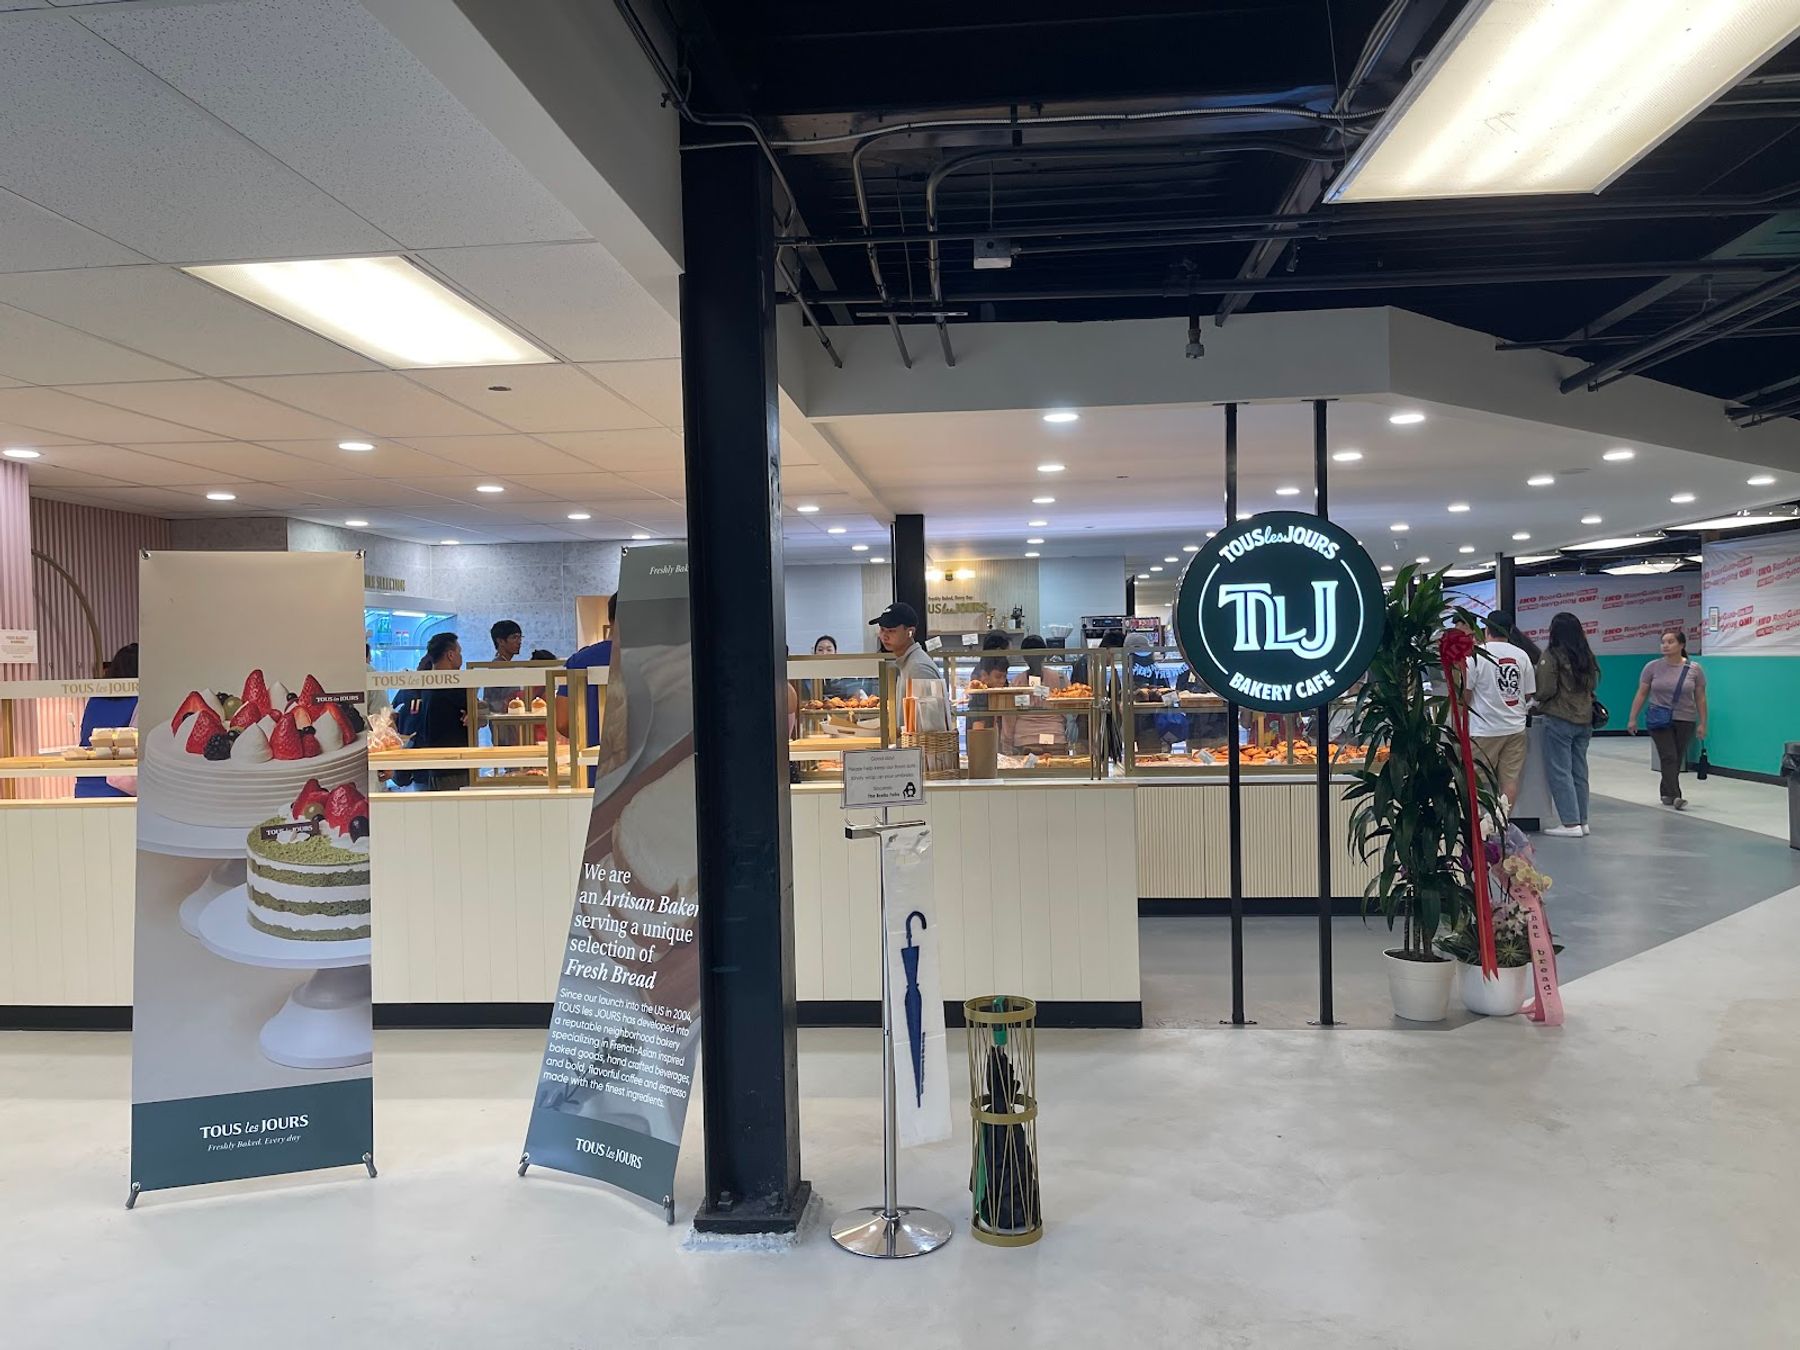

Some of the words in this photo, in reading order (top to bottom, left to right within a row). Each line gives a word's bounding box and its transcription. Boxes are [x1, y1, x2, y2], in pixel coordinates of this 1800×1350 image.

[1218, 528, 1264, 563] TOUS
[1264, 525, 1287, 544] les
[1284, 525, 1340, 560] JOURS
[649, 565, 675, 576] Freshly
[1218, 580, 1339, 660] TLJ
[61, 683, 94, 694] TOUS
[96, 683, 108, 693] les
[109, 682, 139, 694] JOUR
[372, 676, 406, 687] TOUS
[407, 676, 419, 686] les
[421, 674, 460, 687] JOURS
[1229, 672, 1292, 701] BAKERY
[1295, 670, 1336, 699] CAFE
[584, 863, 606, 881] We
[610, 868, 631, 884] are
[580, 890, 597, 905] an
[600, 890, 655, 912] Artisan
[657, 895, 699, 917] Baker
[574, 914, 628, 939] serving
[630, 922, 639, 935] a
[643, 922, 693, 946] unique
[570, 936, 635, 961] selection
[639, 945, 656, 963] of
[564, 958, 607, 981] Fresh
[611, 965, 657, 989] Bread
[560, 988, 582, 1001] Since
[584, 993, 597, 1004] our
[599, 994, 624, 1008] launch
[625, 1001, 640, 1011] into
[641, 1003, 654, 1013] the
[654, 1005, 665, 1016] US
[665, 1007, 673, 1017] in
[554, 1017, 561, 1025] a
[562, 1018, 602, 1033] reputable
[603, 1026, 655, 1044] neighborhood
[656, 1034, 680, 1051] bakery
[558, 1001, 581, 1014] TOUS
[581, 1004, 593, 1017] les
[594, 1008, 621, 1022] JOURS
[622, 1013, 636, 1024] has
[637, 1017, 674, 1033] developed
[675, 1025, 690, 1036] into
[550, 1043, 577, 1056] baked
[577, 1049, 605, 1064] goods,
[606, 1053, 627, 1067] hand
[628, 1060, 654, 1073] crafted
[654, 1064, 690, 1085] beverages,
[552, 1030, 600, 1048] specializing
[601, 1039, 609, 1048] in
[610, 1040, 657, 1058] French-Asian
[658, 1051, 685, 1067] inspired
[543, 1071, 569, 1084] made
[570, 1077, 588, 1088] with
[590, 1080, 604, 1091] the
[605, 1083, 625, 1096] finest
[626, 1089, 665, 1108] ingredients.
[546, 1058, 564, 1068] and
[565, 1059, 585, 1072] bold,
[588, 1064, 620, 1080] flavorful
[621, 1073, 643, 1086] coffee
[643, 1079, 658, 1090] and
[659, 1083, 687, 1099] espresso
[200, 1122, 242, 1139] TOUS
[245, 1121, 259, 1133] les
[260, 1114, 309, 1133] JOURS
[207, 1141, 235, 1151] Freshly
[264, 1137, 286, 1145] Every
[286, 1134, 301, 1143] day
[576, 1137, 605, 1157] TOUS
[605, 1146, 615, 1159] les
[614, 1149, 643, 1169] JOURS
